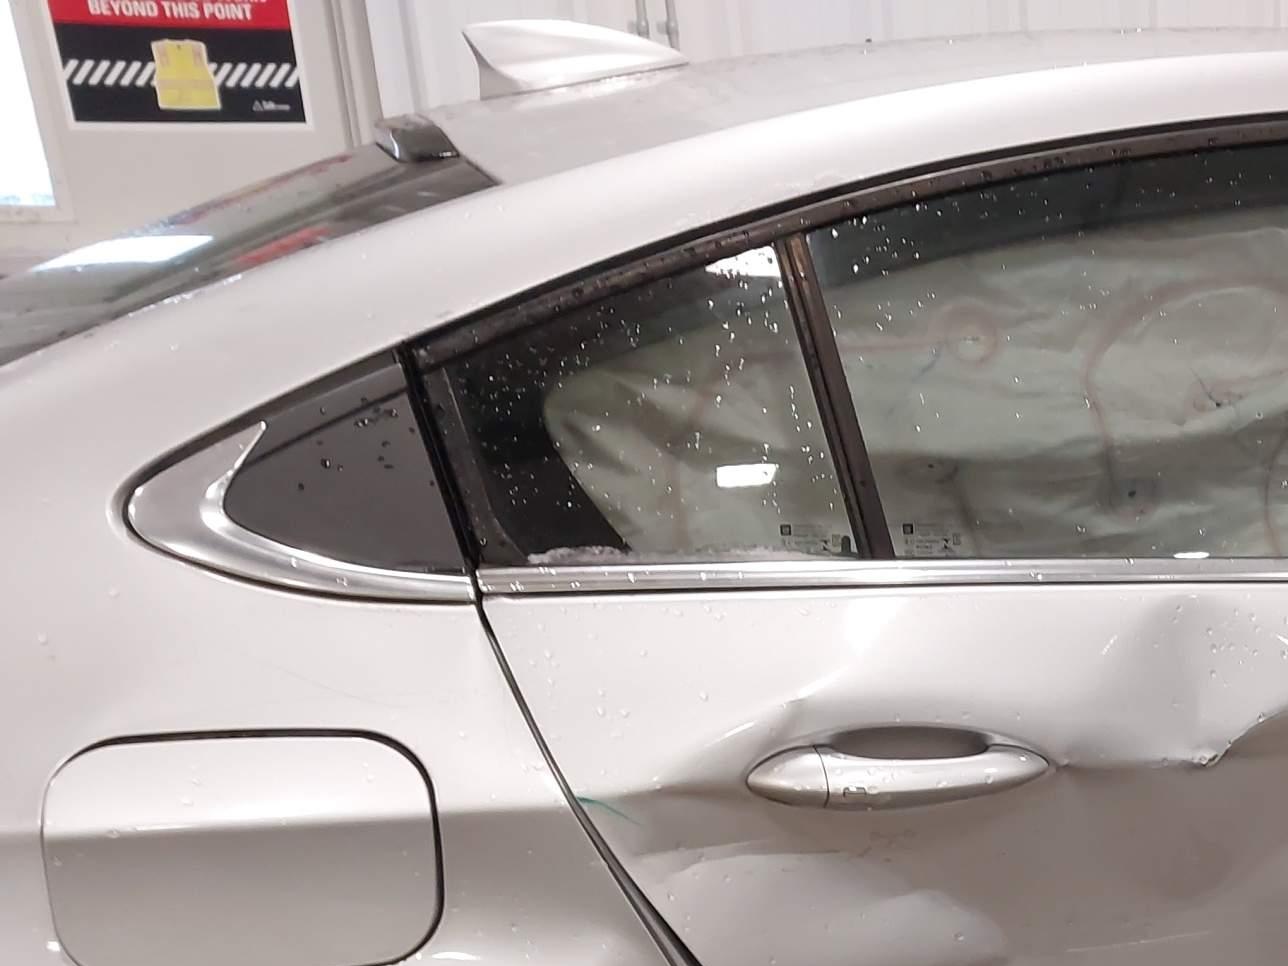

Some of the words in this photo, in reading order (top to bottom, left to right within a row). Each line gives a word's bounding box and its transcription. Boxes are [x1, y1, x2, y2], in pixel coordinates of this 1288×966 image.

[88, 0, 158, 17] BEYOND
[162, 1, 200, 19] THIS
[204, 3, 252, 20] POINT
